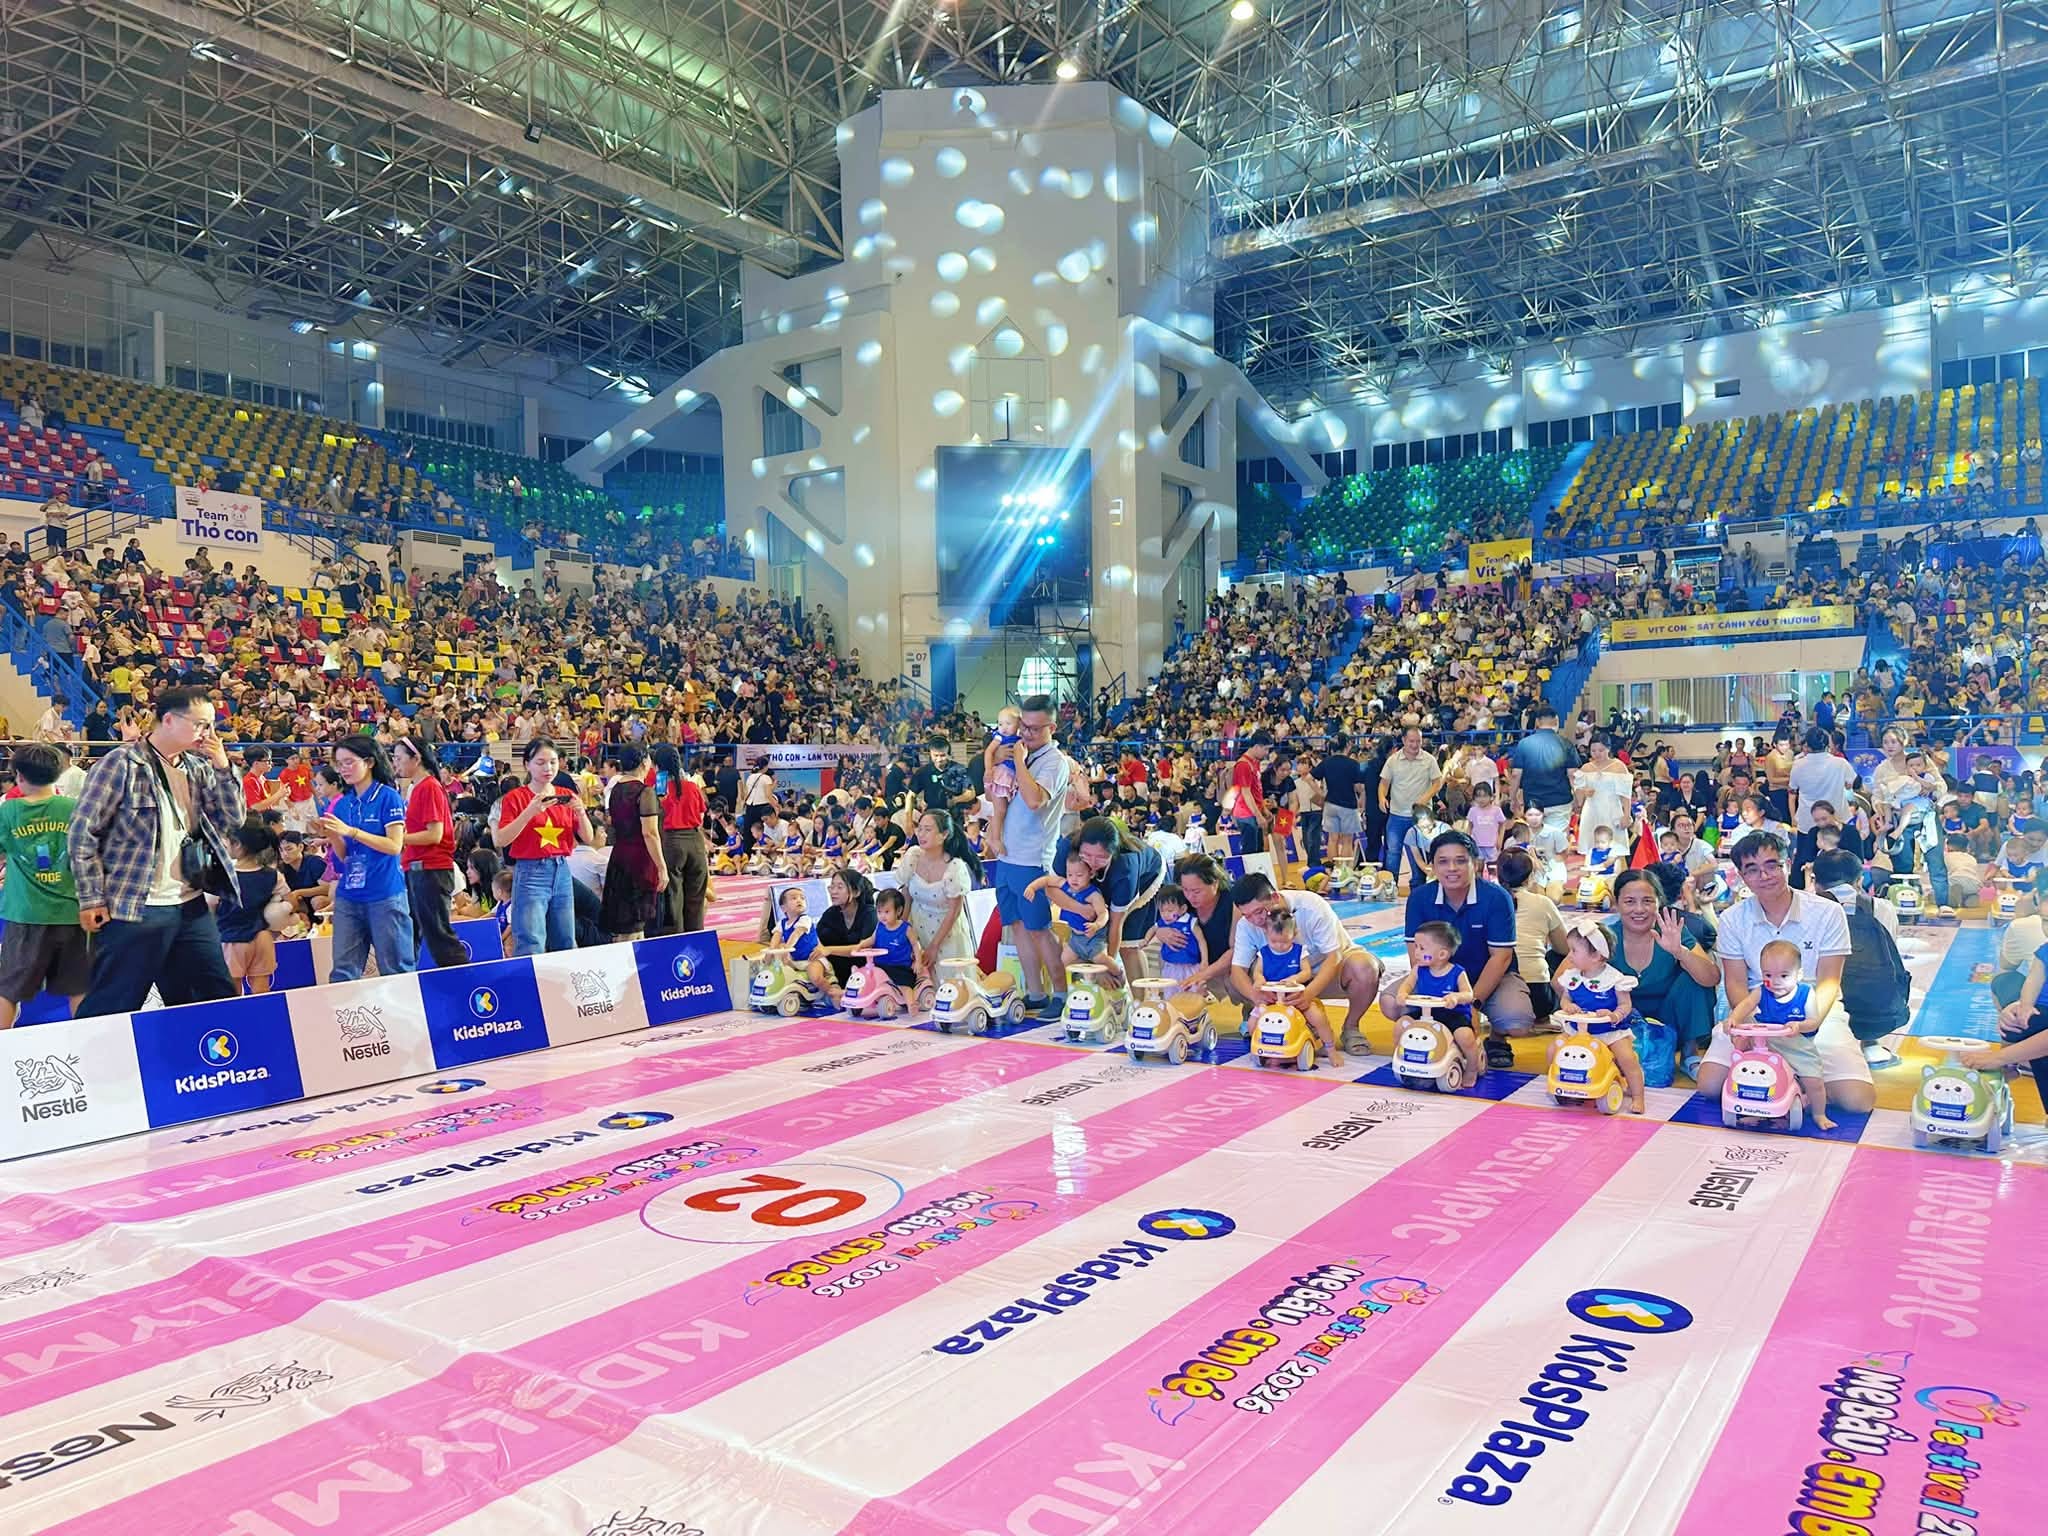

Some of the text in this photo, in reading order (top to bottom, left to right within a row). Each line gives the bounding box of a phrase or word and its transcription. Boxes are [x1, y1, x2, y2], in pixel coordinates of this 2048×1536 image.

[196, 507, 229, 522] Team
[181, 518, 259, 544] Thỏ con
[1667, 624, 1687, 633] CON
[915, 652, 927, 662] 07
[785, 753, 800, 761] CON
[808, 753, 822, 761] LAN
[660, 982, 714, 1002] KidsPlaza
[577, 999, 614, 1018] Nestlé
[452, 1018, 523, 1042] KidsPlaza
[342, 1041, 391, 1062] Nestlé
[175, 1065, 269, 1095] KidsPlaza
[22, 1095, 88, 1123] Nestlé
[1302, 1112, 1383, 1151] Nestlé
[356, 1129, 602, 1197] KidsPlaza
[684, 1173, 867, 1227] 02
[1687, 1165, 1759, 1212] Nestlé
[521, 1191, 608, 1222] 2026
[1882, 1168, 1997, 1339] KIDSLYMPIC
[811, 1259, 902, 1299] 2026
[932, 1239, 1169, 1356] KidsPlaza
[1232, 1298, 1393, 1416] Festival 2026
[1444, 1333, 1637, 1508] KidsPlaza
[1919, 1418, 1985, 1520] Festival
